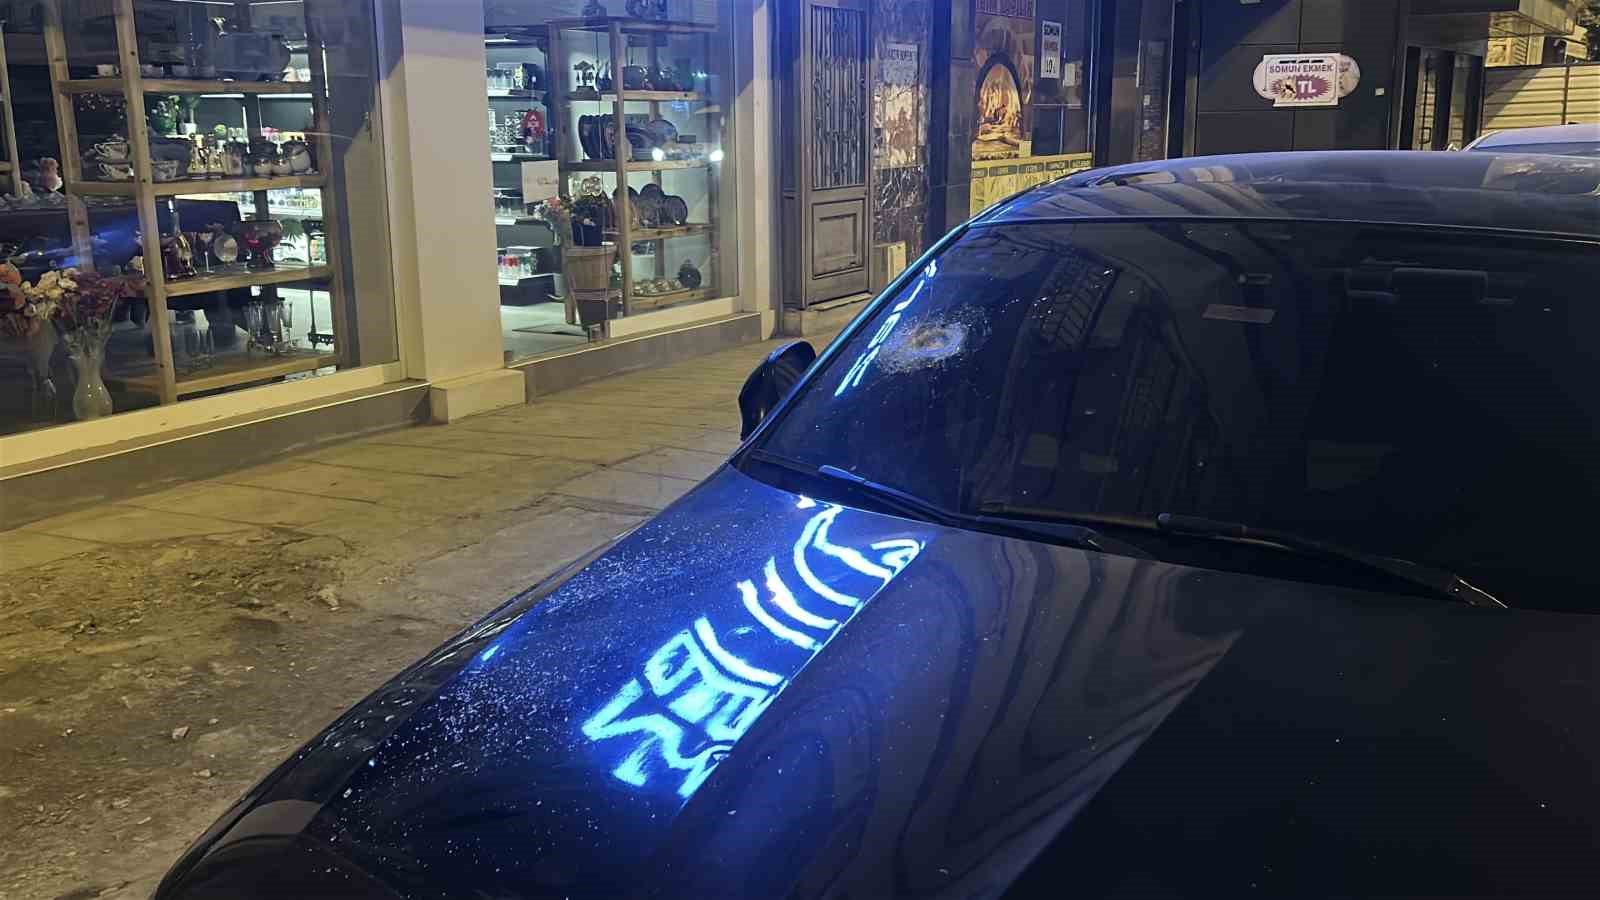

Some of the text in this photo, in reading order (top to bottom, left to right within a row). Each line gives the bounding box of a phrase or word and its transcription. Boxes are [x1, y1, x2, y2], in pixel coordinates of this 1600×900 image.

[1269, 64, 1301, 73] SOMUN
[1303, 64, 1334, 72] EKMEK
[1297, 80, 1317, 93] TL
